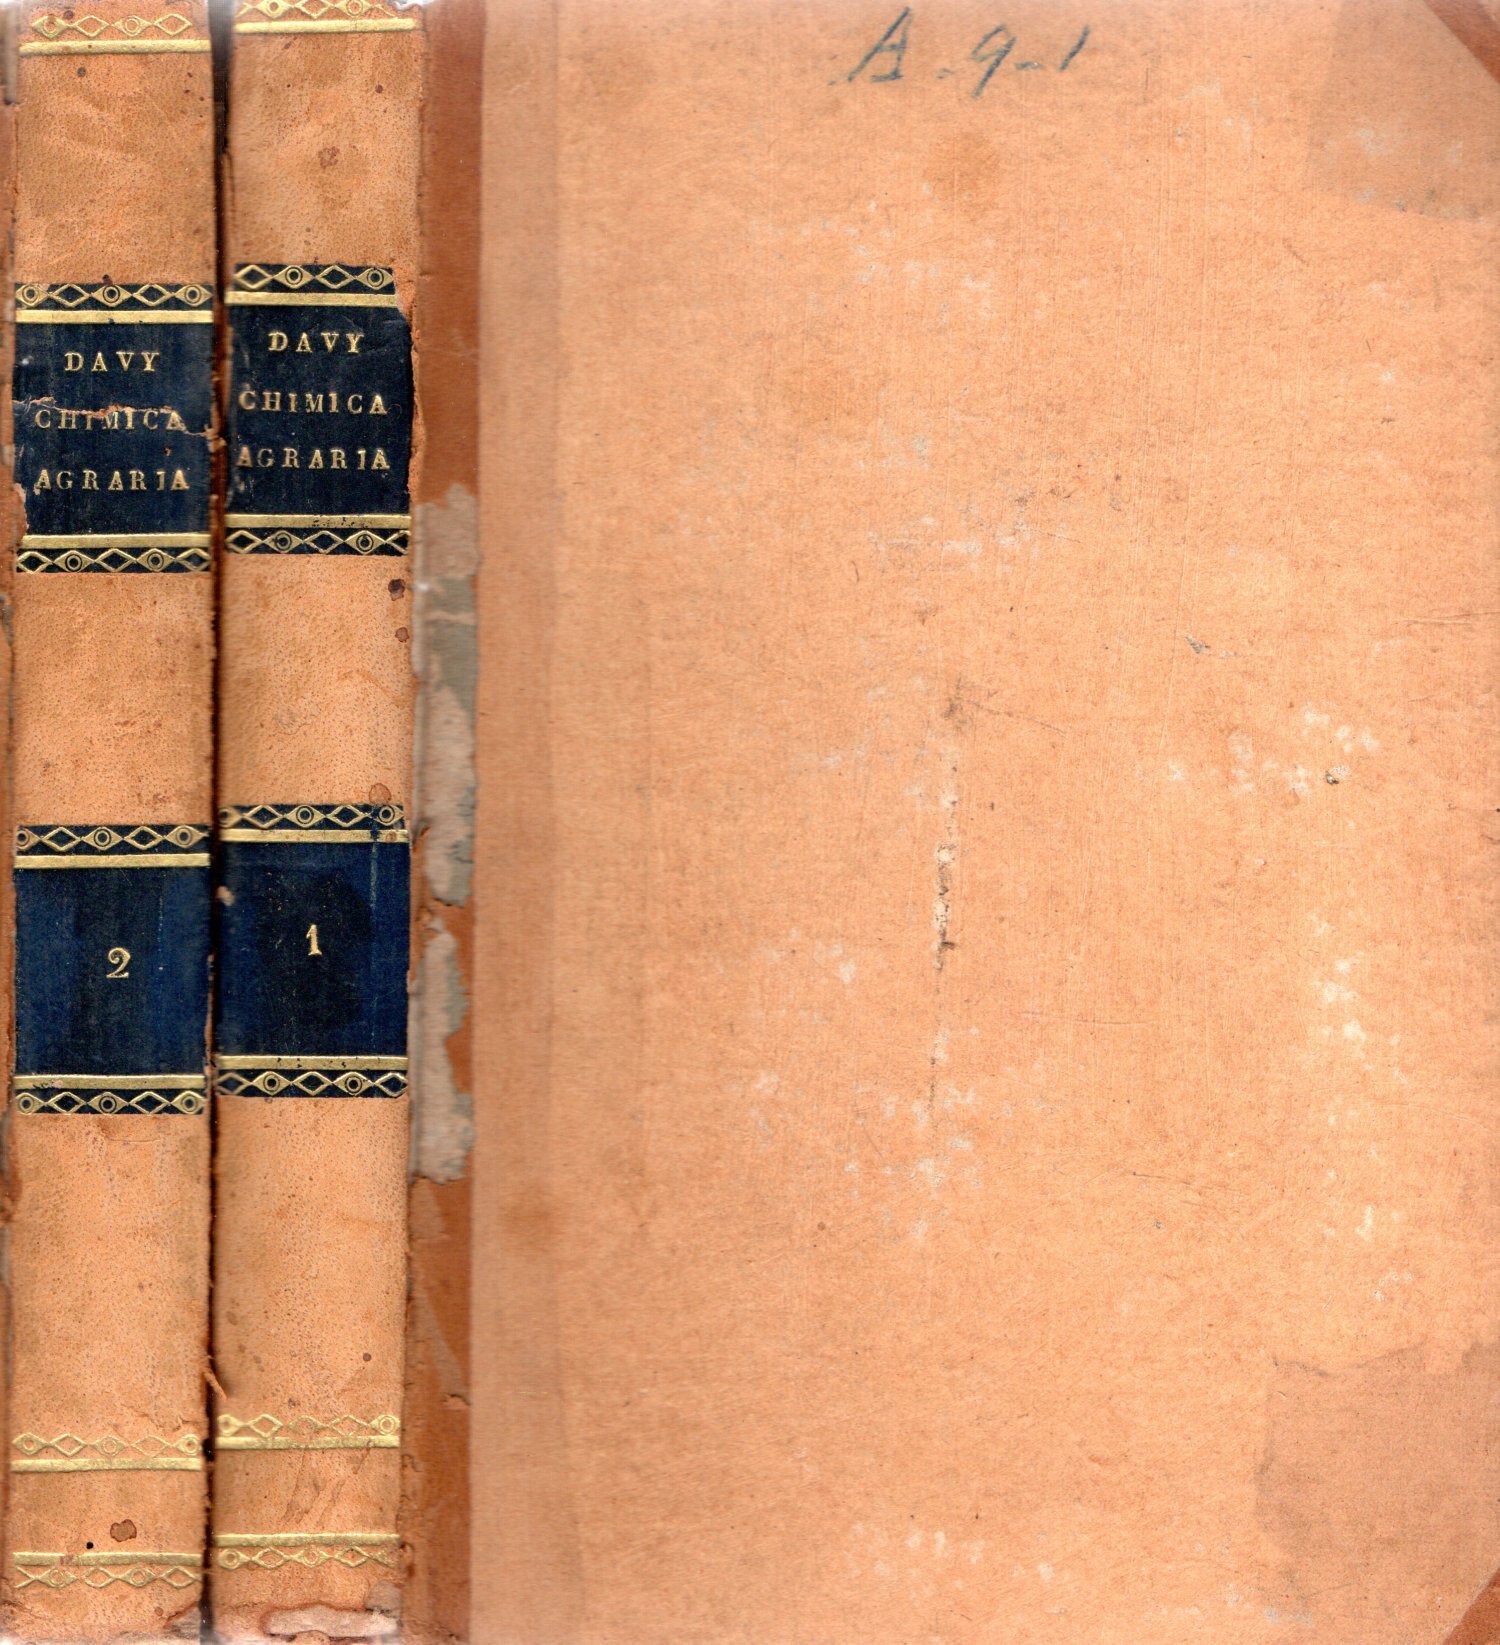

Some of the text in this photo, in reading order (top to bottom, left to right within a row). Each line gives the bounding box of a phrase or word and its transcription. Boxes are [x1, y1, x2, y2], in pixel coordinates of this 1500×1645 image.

[268, 331, 365, 354] DAVY
[65, 351, 160, 372] DAVY
[238, 390, 388, 416] CHIMICA
[34, 409, 185, 431] CHIMICA
[236, 446, 390, 471] AGRARIA
[34, 469, 190, 491] AGRARIA
[306, 924, 322, 956] 1
[106, 947, 131, 979] 2
